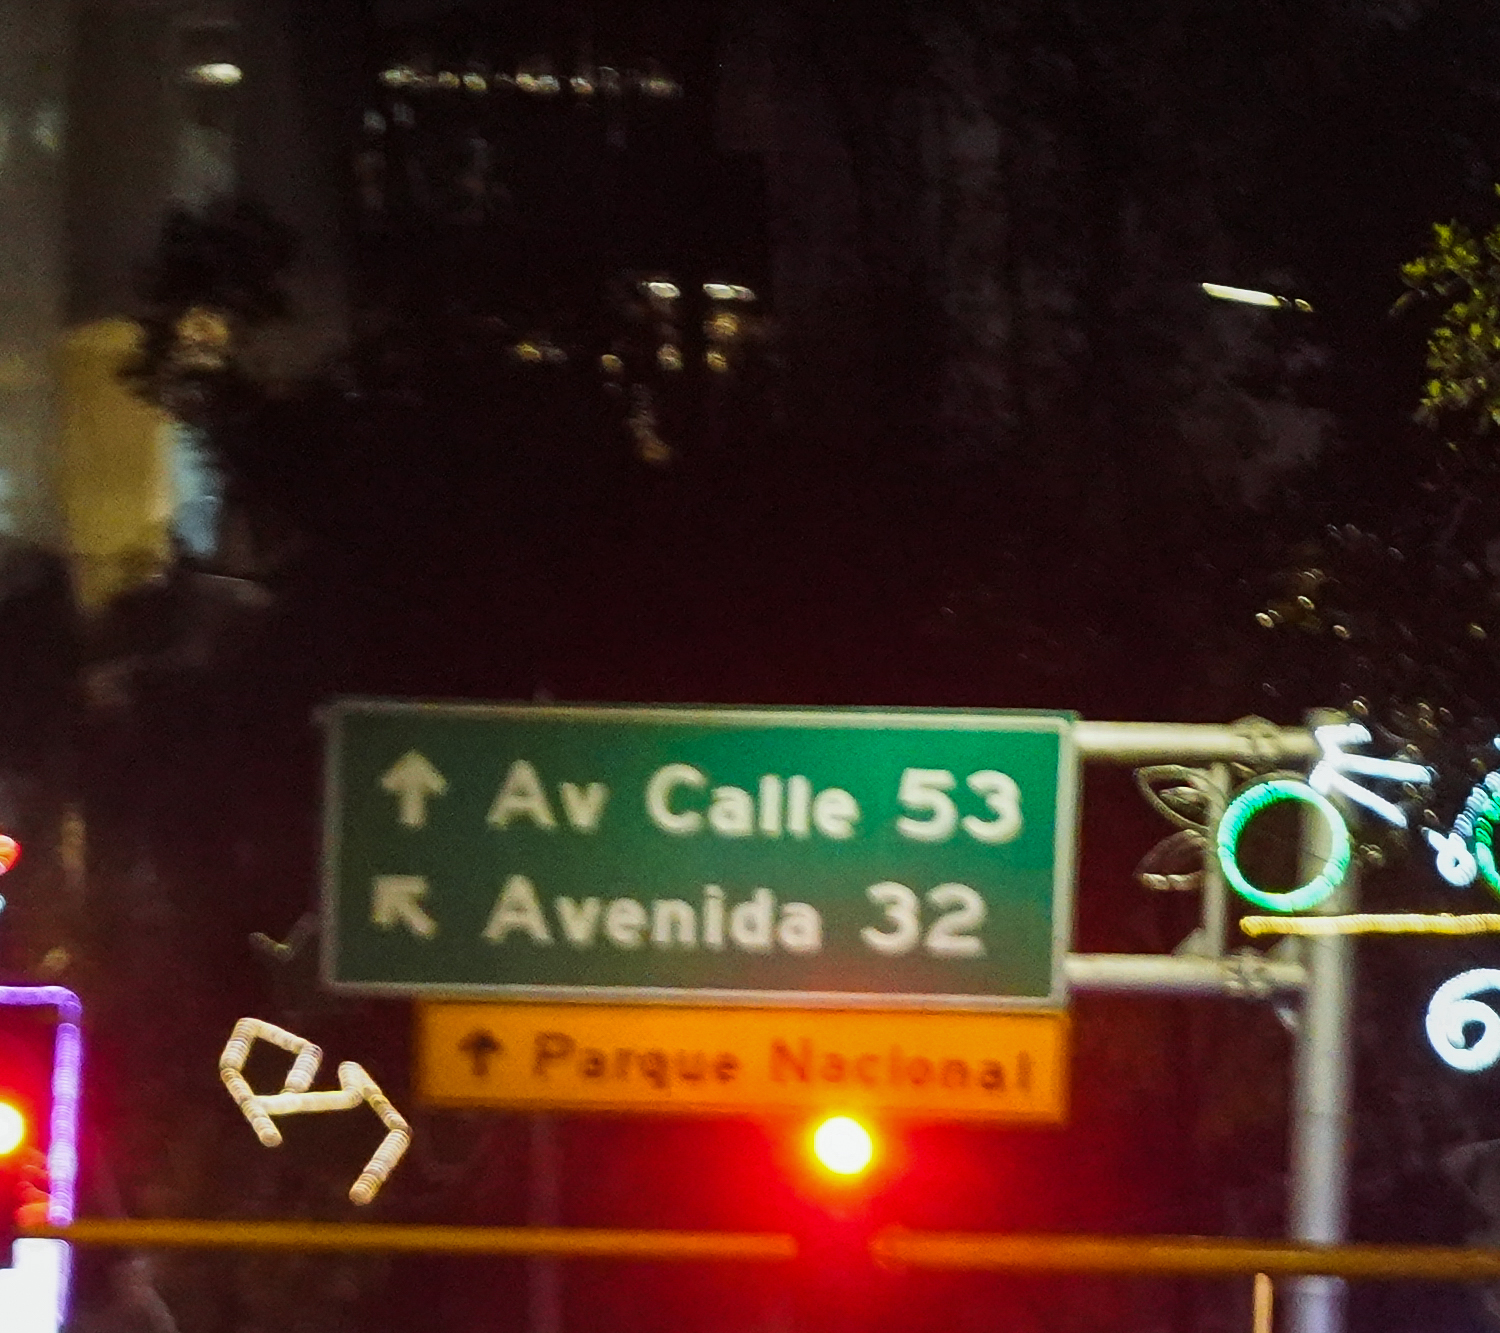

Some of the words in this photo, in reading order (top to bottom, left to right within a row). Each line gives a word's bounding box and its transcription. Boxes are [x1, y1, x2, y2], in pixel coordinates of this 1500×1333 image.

[486, 760, 608, 833] Av
[645, 763, 861, 841] Calle
[895, 768, 1023, 844] 53
[484, 874, 824, 953] Avenida
[860, 881, 987, 957] 32
[532, 1030, 741, 1092] Parque
[768, 1039, 1037, 1094] Nacional
